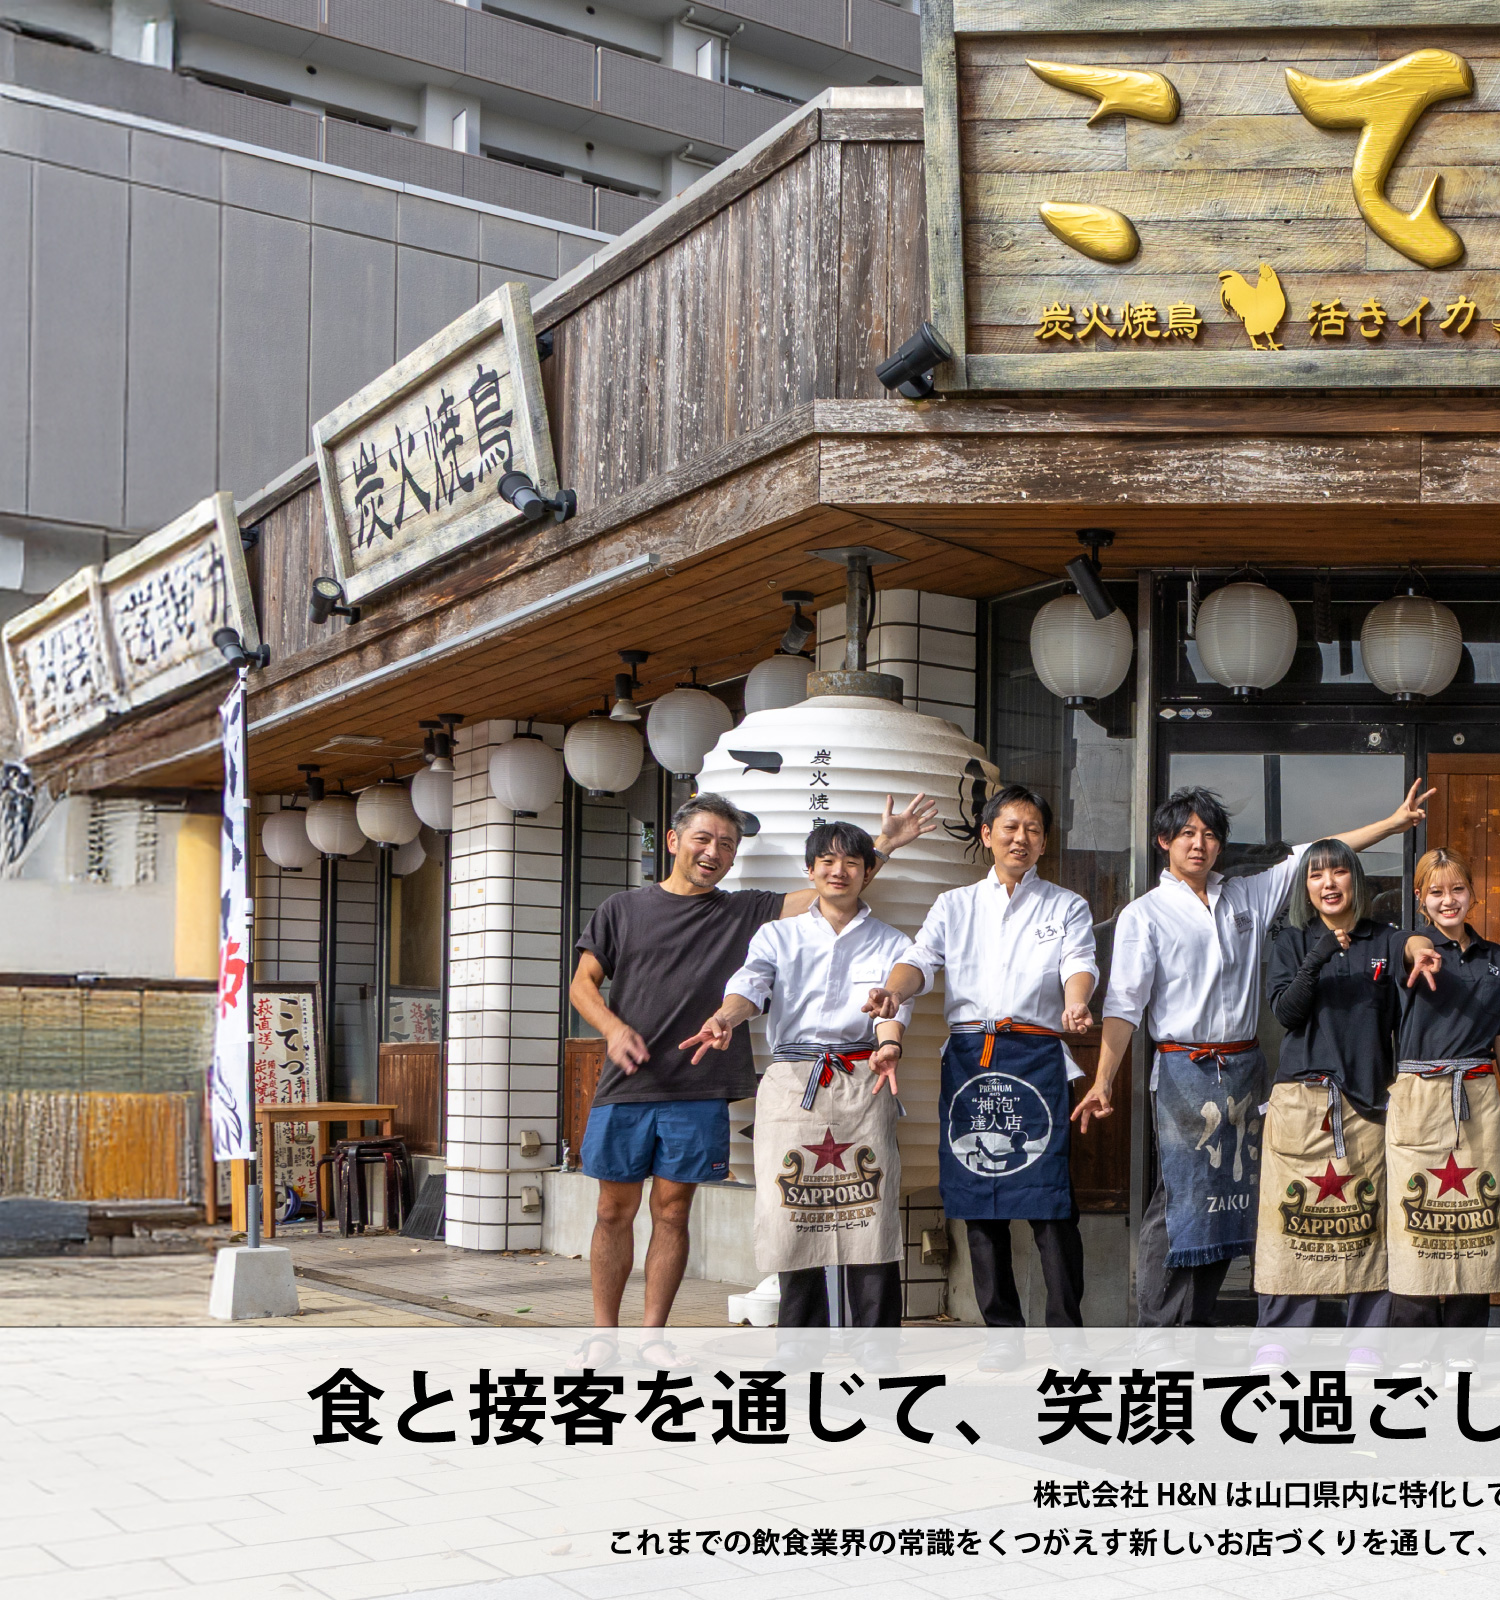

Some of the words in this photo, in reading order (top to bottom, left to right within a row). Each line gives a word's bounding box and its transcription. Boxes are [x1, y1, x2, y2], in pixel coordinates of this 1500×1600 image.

[1034, 300, 1203, 341] 炭火焼鳥
[1308, 295, 1477, 336] 活きイカ
[353, 364, 514, 549] 炭火焼鳥
[276, 997, 305, 1075] こてつ
[978, 1084, 1013, 1093] PREMIUM
[970, 1114, 1023, 1131] 達人店
[786, 1181, 875, 1206] SAPPORO
[1206, 1193, 1250, 1213] ZAKU
[789, 1211, 836, 1223] LAGER
[837, 1206, 877, 1220] BEER
[1409, 1208, 1495, 1231] SAPPORO
[795, 1220, 870, 1233] サッポロラガービール
[1287, 1213, 1373, 1235] SAPPORO
[1289, 1239, 1336, 1253] LAGER
[1337, 1237, 1373, 1252] BEER
[1411, 1235, 1458, 1250] LAGER
[1460, 1235, 1496, 1249] BEER
[1294, 1252, 1367, 1262] サッポロラガービール
[1417, 1249, 1489, 1260] サッポロラガービール
